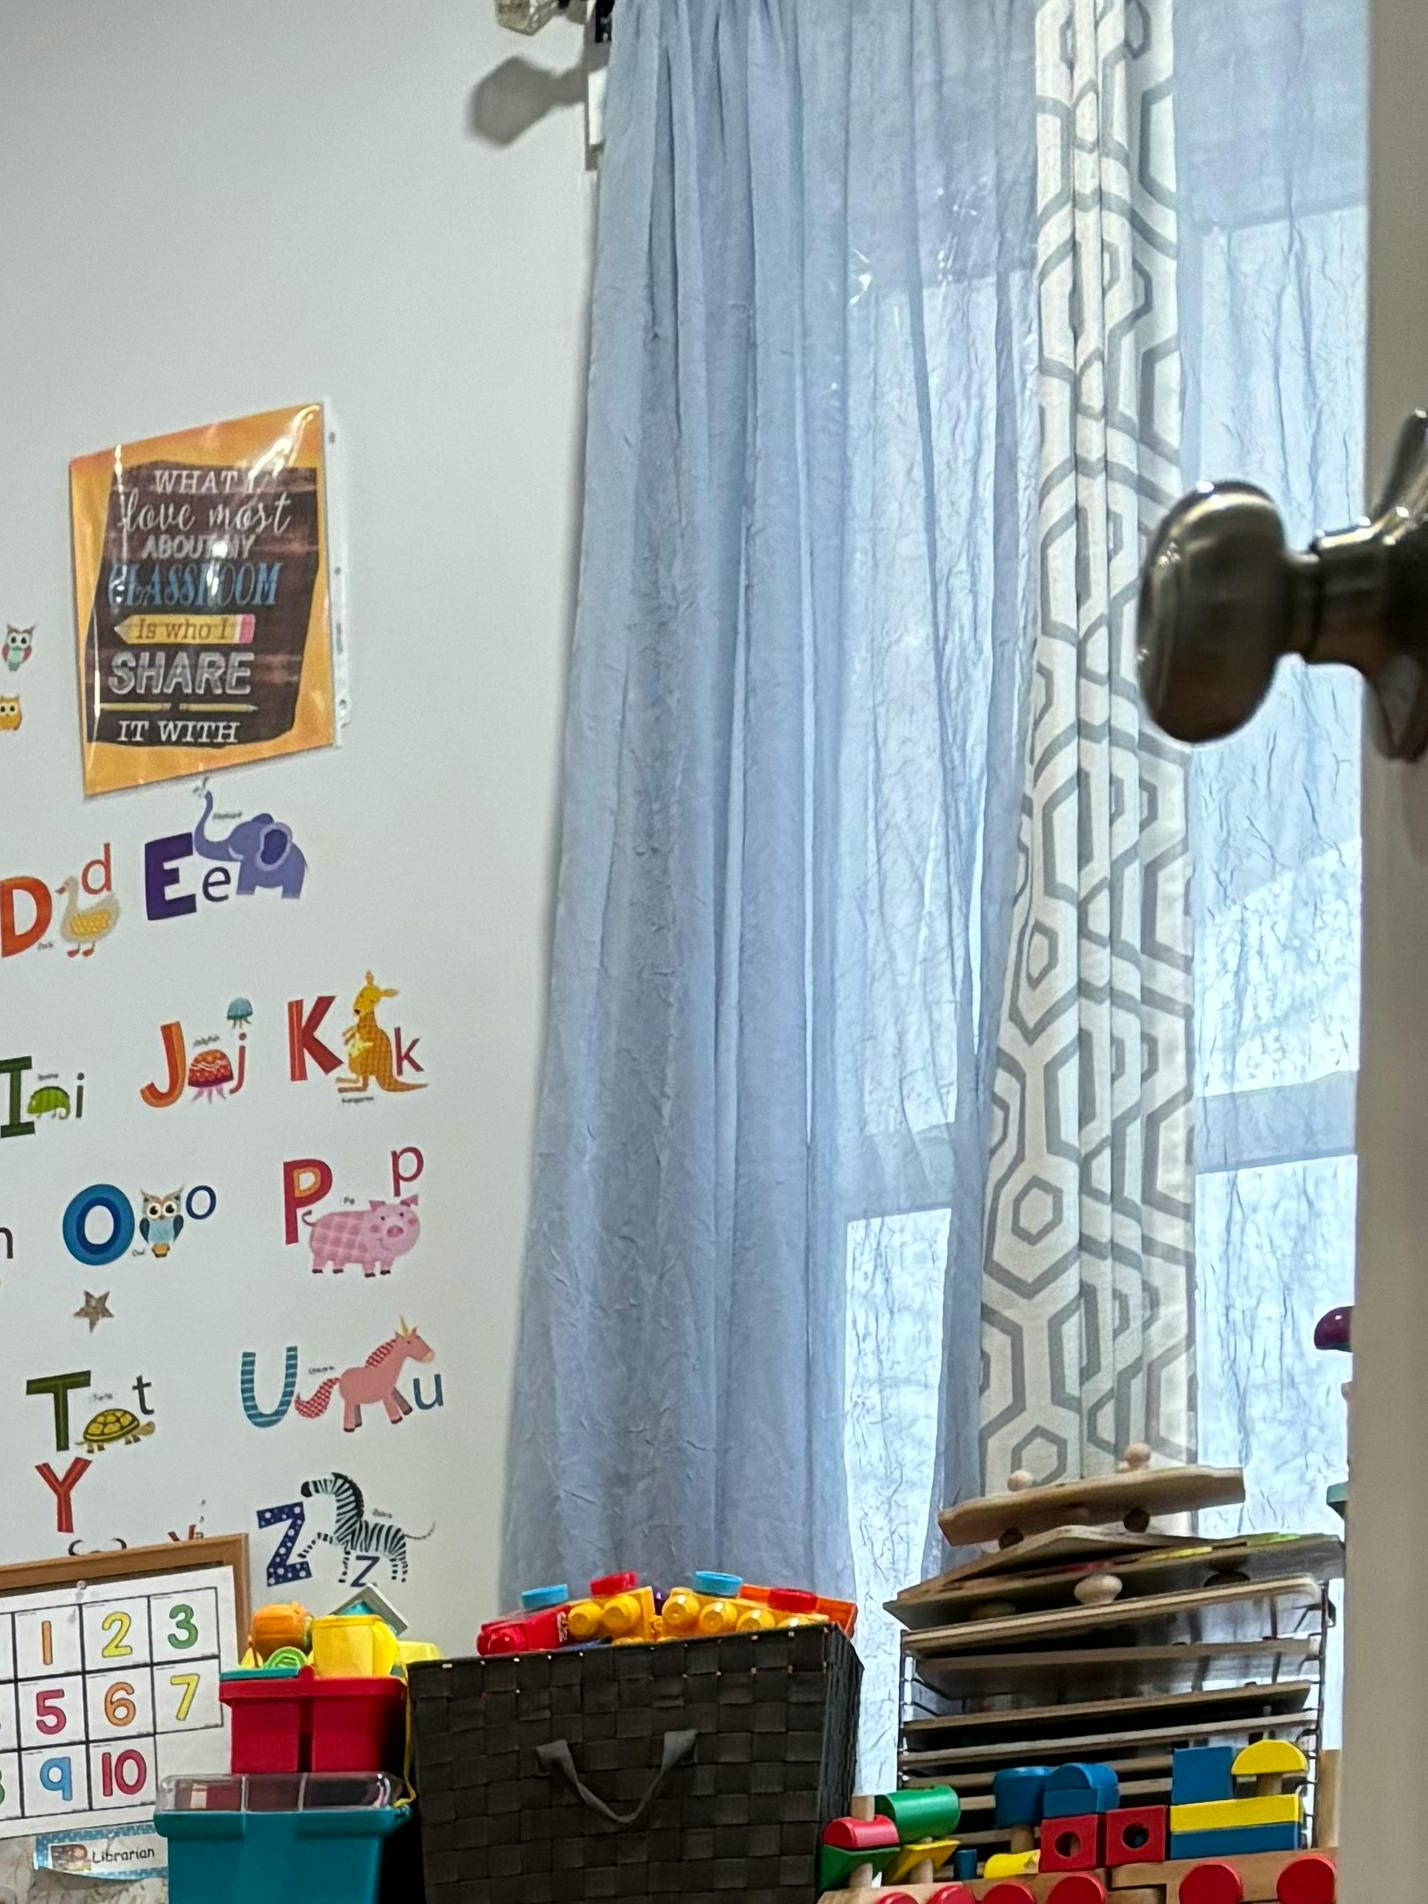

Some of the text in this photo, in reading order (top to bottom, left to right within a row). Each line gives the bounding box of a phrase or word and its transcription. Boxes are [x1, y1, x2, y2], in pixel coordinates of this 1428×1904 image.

[154, 470, 237, 495] WHAT
[124, 490, 292, 534] love most
[142, 535, 216, 560] ABOUT
[108, 561, 282, 608] CLASSROOM
[136, 616, 231, 641] Is who I
[108, 651, 255, 696] SHARE
[117, 720, 239, 744] IT WITH
[0, 875, 53, 958] D
[287, 996, 345, 1082] K
[63, 1183, 136, 1266] O
[283, 1159, 333, 1246] P
[26, 1370, 92, 1452] T
[241, 1346, 299, 1429] U
[41, 1620, 53, 1666] 1
[101, 1611, 133, 1658] 2
[167, 1603, 198, 1649] 3
[35, 1688, 67, 1735] 5
[104, 1681, 136, 1727] 6
[169, 1673, 201, 1721] 7
[39, 1756, 72, 1801] 9
[101, 1748, 148, 1798] 10
[92, 1844, 156, 1864] Librarian
